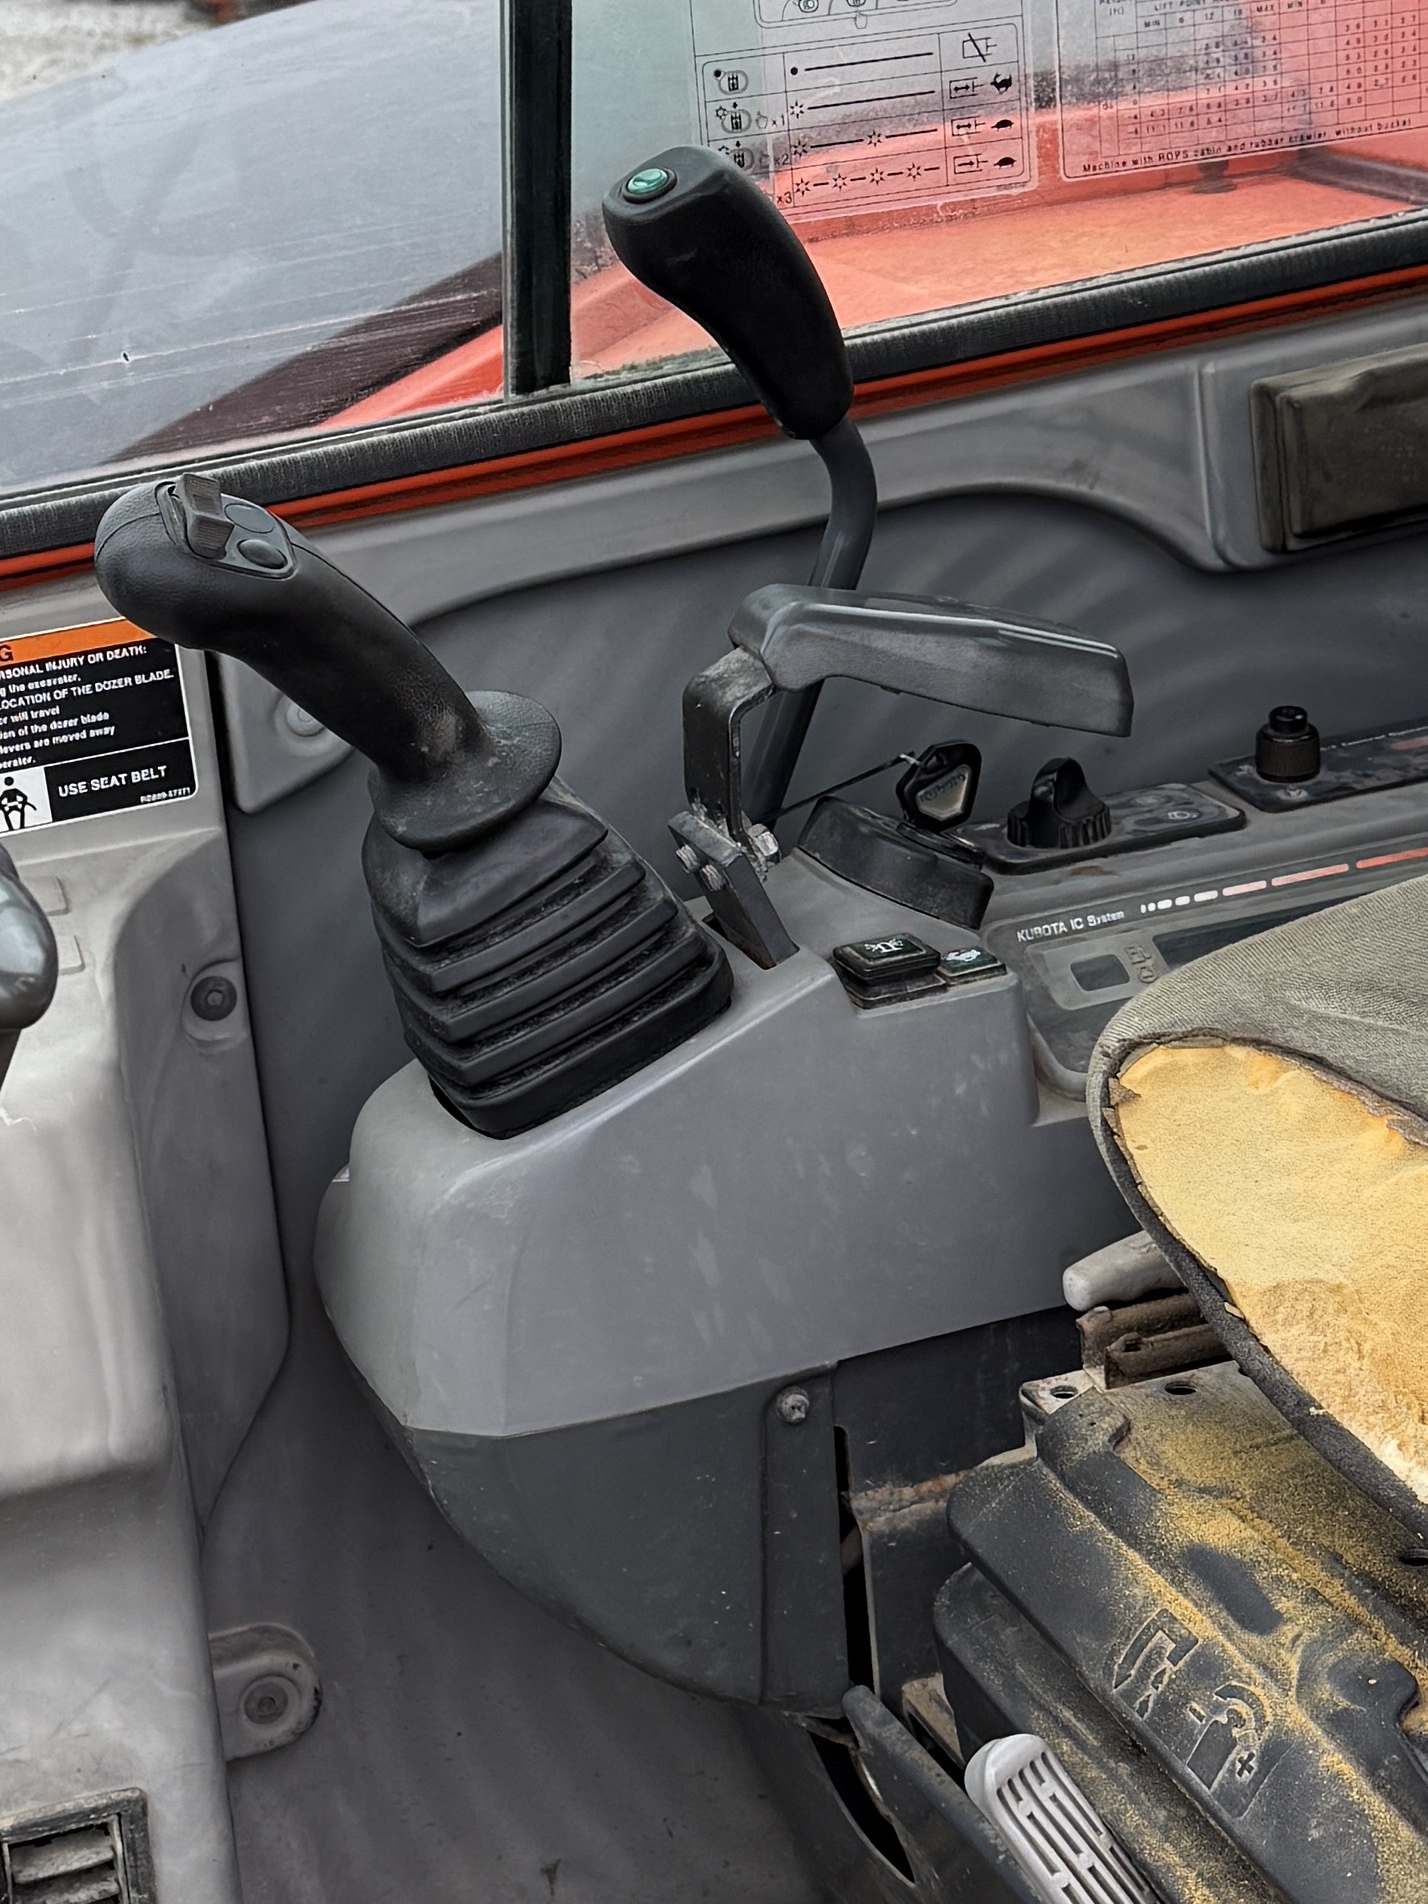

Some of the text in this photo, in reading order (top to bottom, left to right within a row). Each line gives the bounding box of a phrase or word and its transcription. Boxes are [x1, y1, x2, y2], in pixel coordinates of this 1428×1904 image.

[44, 656, 84, 671] INJURY
[87, 653, 104, 663] OR
[106, 646, 146, 660] DEATH:
[8, 683, 25, 693] the
[53, 688, 68, 699] OF
[69, 683, 93, 696] THE
[94, 676, 132, 692] DOZER
[9, 711, 28, 722] will
[30, 705, 59, 718] travel
[17, 725, 28, 736] of
[30, 724, 47, 733] the
[80, 712, 109, 724] blade
[33, 738, 49, 748] are
[52, 729, 87, 744] moved
[89, 725, 114, 737] away
[58, 765, 166, 797] USE SEAT BELT
[1016, 922, 1068, 941] KUBOTA
[1069, 918, 1084, 930] IC
